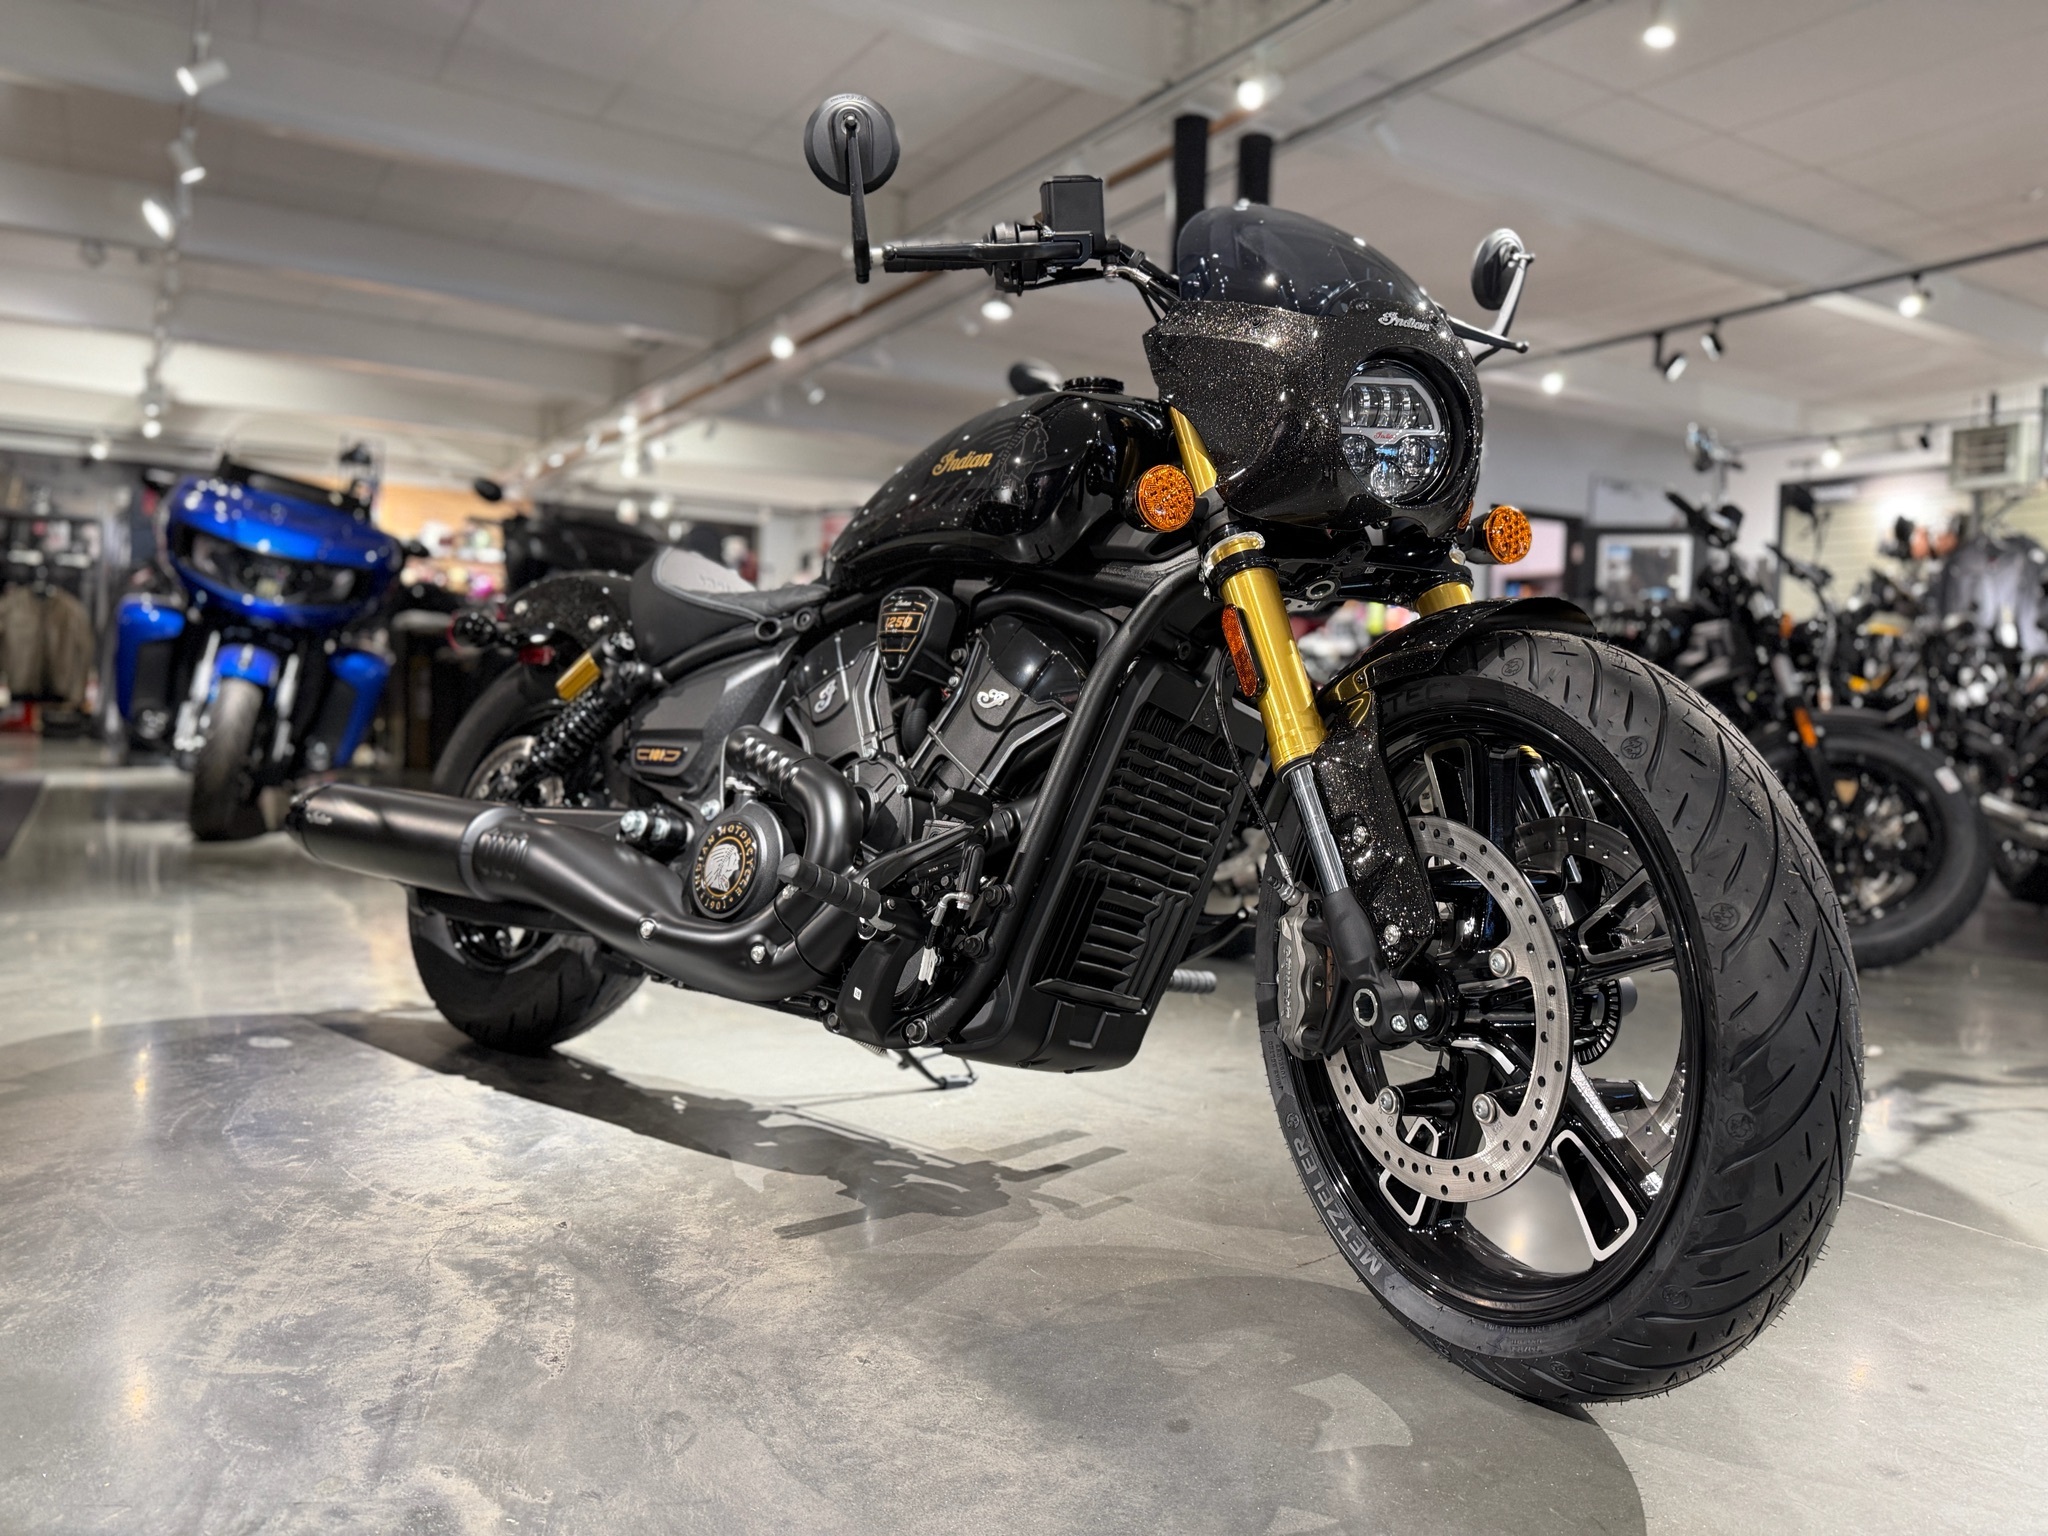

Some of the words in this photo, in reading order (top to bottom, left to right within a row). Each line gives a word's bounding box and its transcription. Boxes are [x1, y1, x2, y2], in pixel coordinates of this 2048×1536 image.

[1378, 311, 1431, 332] Indian
[931, 448, 994, 477] Indian
[717, 823, 757, 898] MOTORCYCLE
[1294, 1137, 1383, 1276] METZELER
